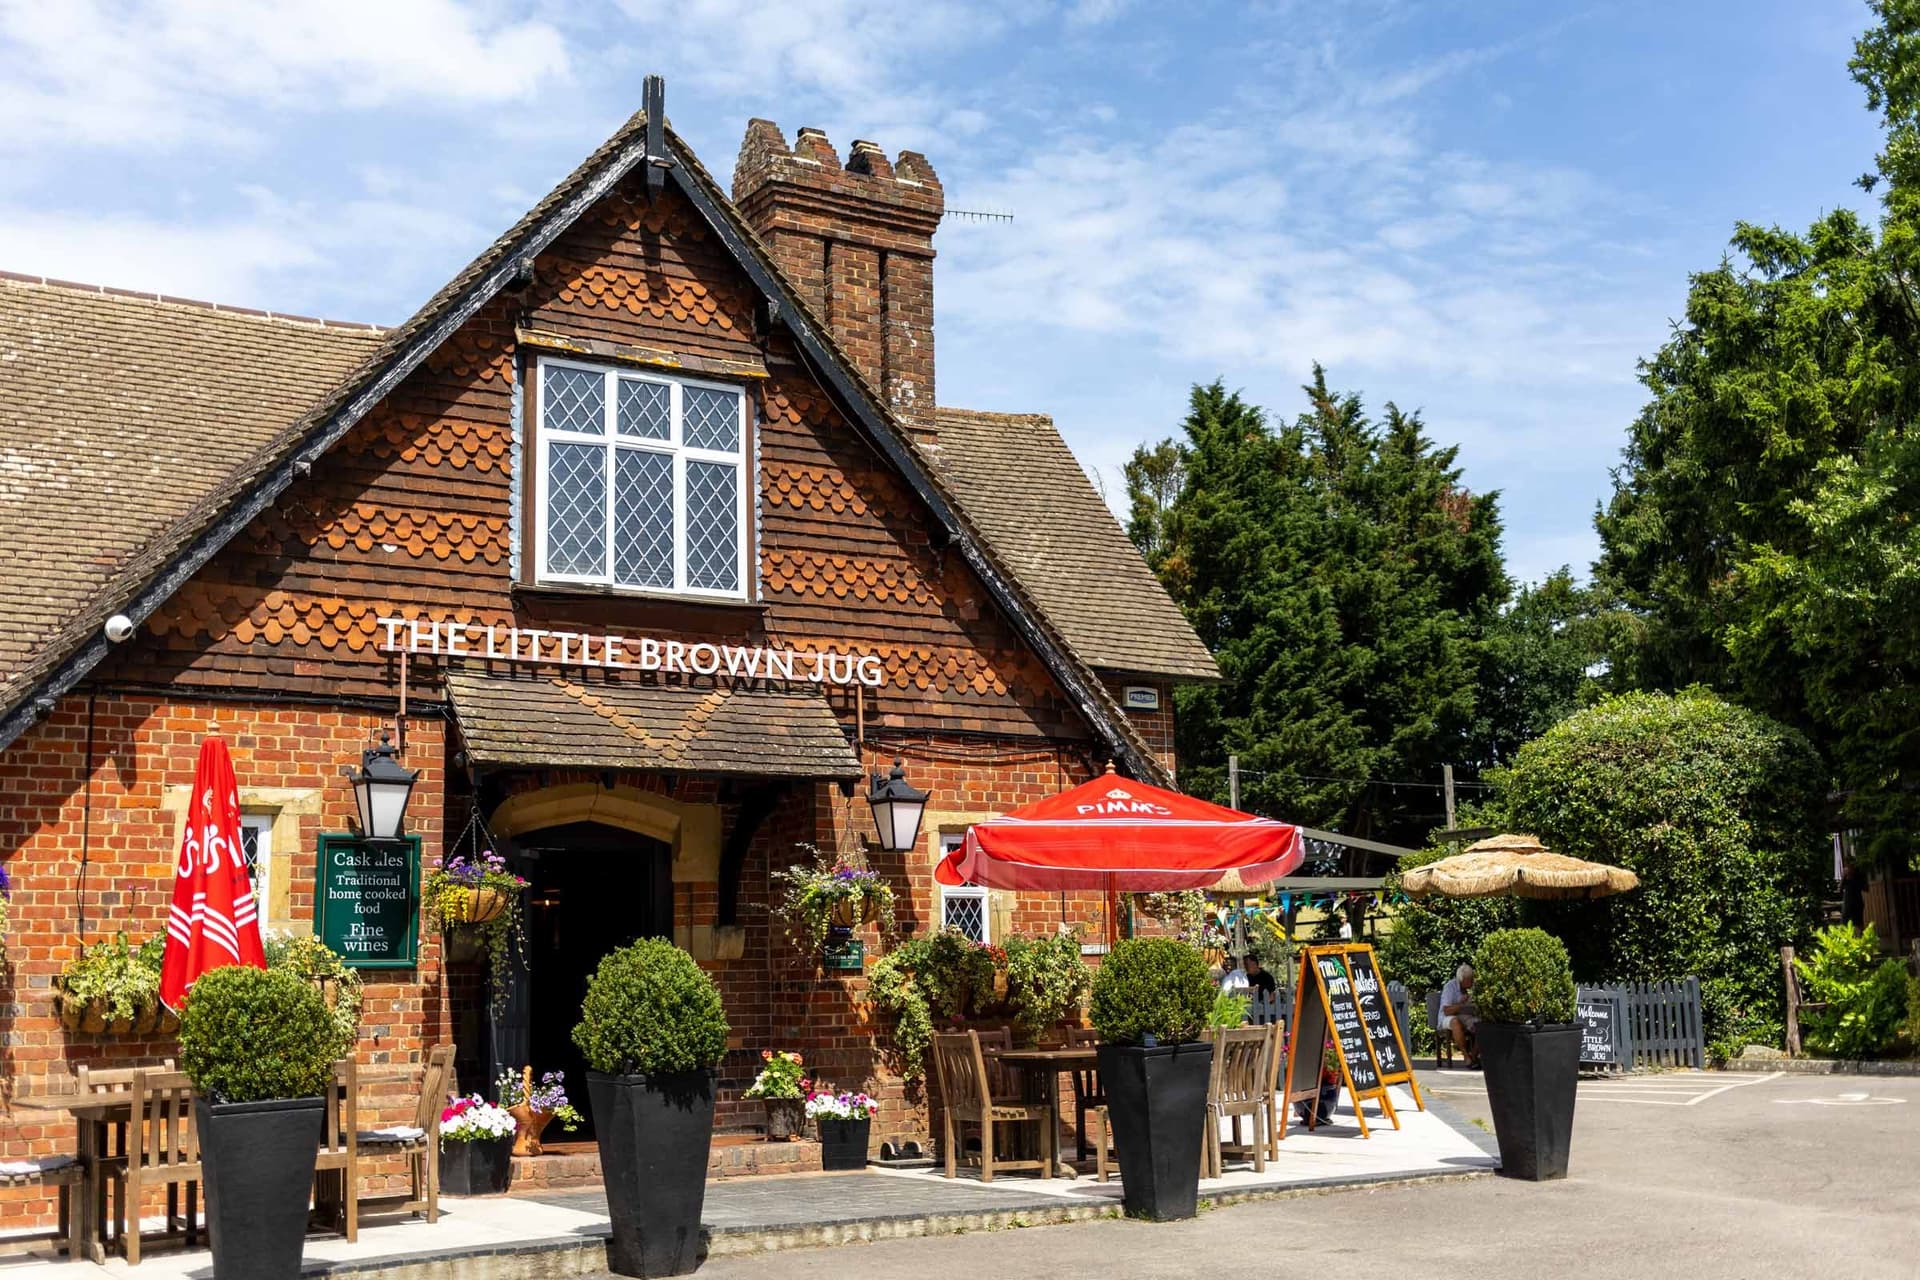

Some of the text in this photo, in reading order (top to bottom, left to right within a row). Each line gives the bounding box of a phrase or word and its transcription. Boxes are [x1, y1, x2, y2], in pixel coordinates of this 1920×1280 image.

[377, 617, 882, 686] THE LITTLE BROWN JUG
[334, 851, 404, 866] Cask ales
[336, 875, 400, 886] Traditional
[329, 887, 406, 899] home cooked
[354, 902, 380, 914] food
[350, 923, 384, 936] Fine
[344, 938, 389, 951] wines
[1328, 976, 1350, 995] HUTS
[1578, 1005, 1608, 1018] Welcome
[1589, 1018, 1597, 1027] to
[1587, 1043, 1611, 1052] BROWN
[1592, 1052, 1606, 1060] JUG
